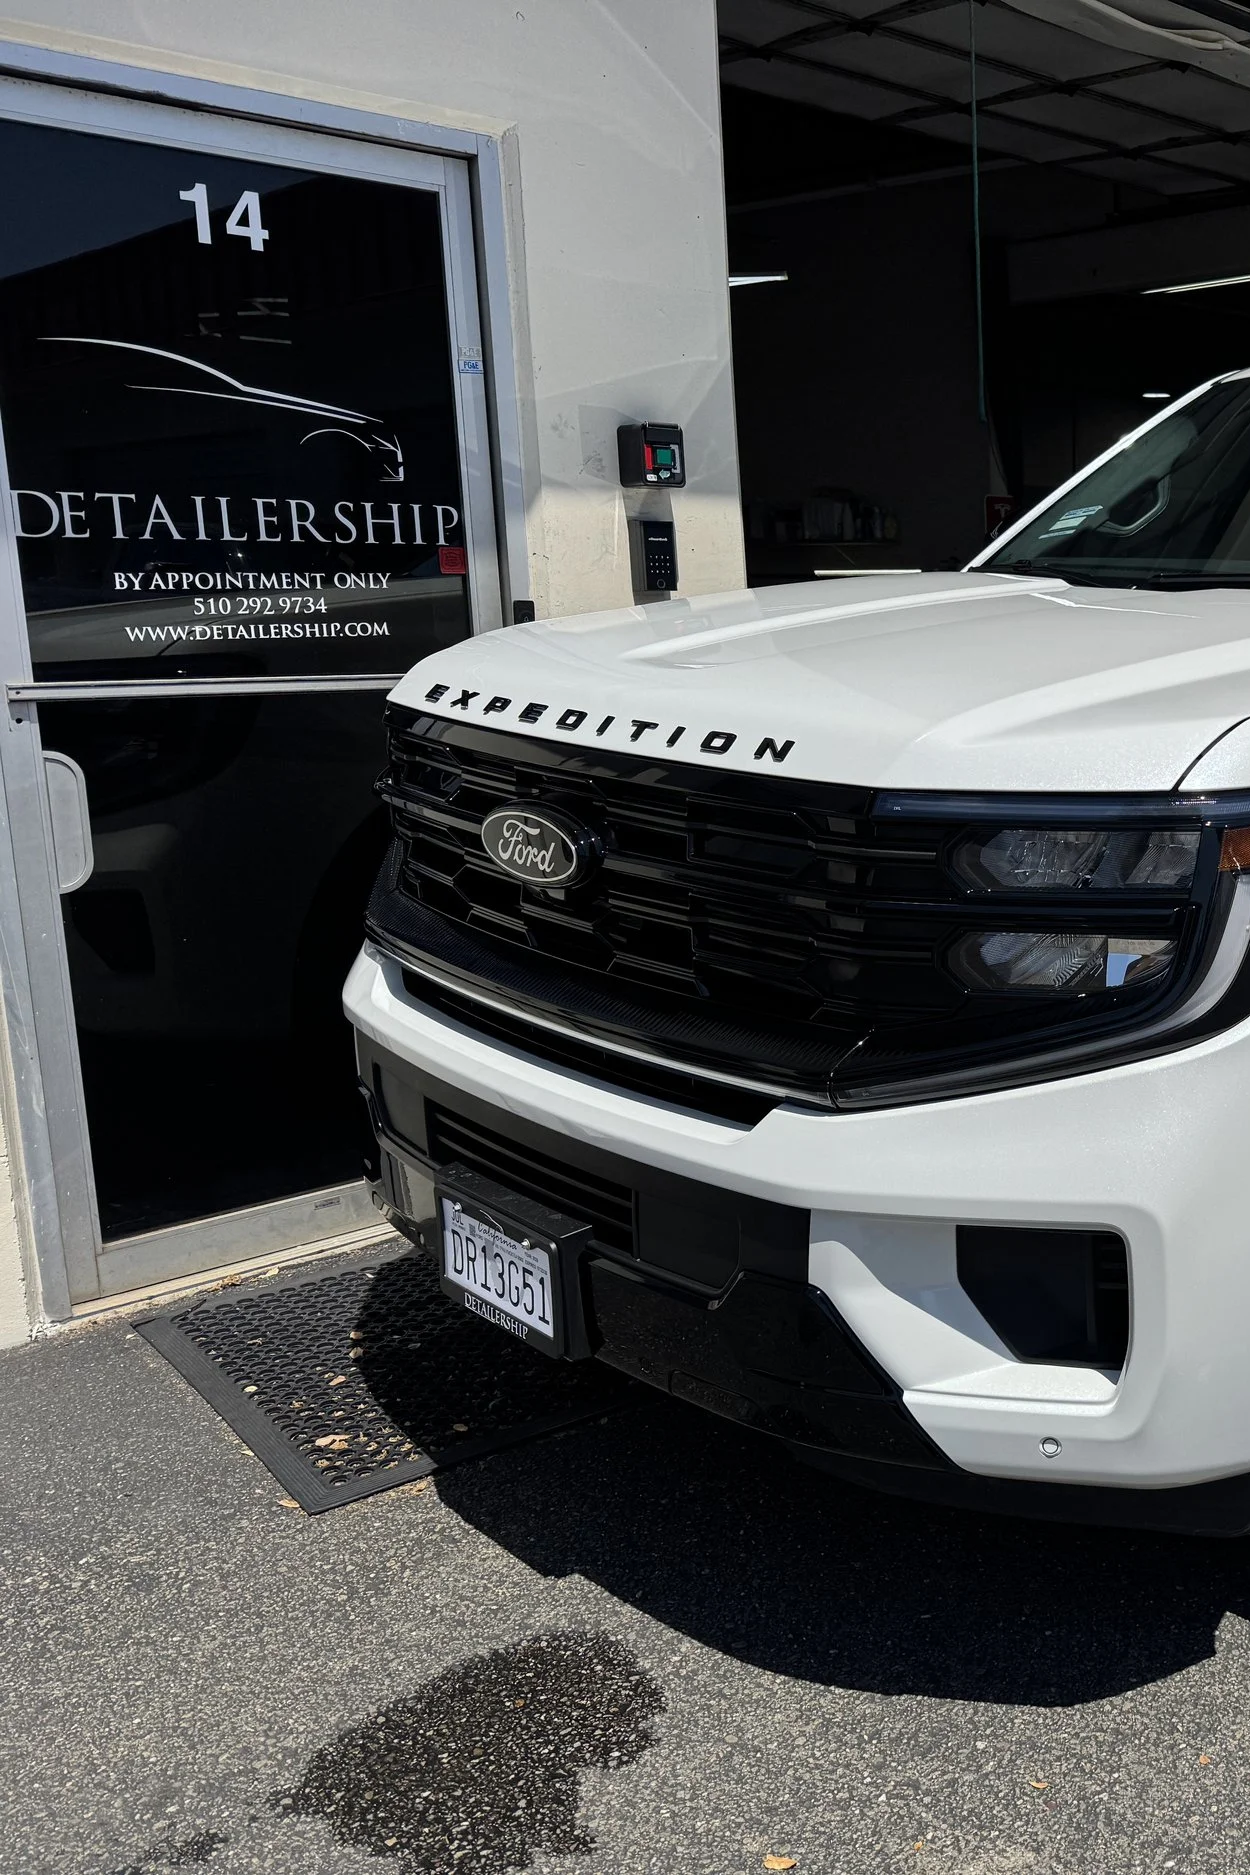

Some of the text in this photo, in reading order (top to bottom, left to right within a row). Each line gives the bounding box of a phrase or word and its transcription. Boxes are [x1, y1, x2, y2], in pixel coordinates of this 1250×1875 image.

[179, 182, 270, 252] 14
[10, 490, 459, 546] DETAILERSHIP
[113, 572, 391, 591] BY APPOINTMENT ONLY
[193, 597, 328, 616] 510 292 9734
[125, 621, 391, 642] WWW.DETAILERSHIP.COM
[424, 683, 796, 763] EXPEDITION
[498, 819, 556, 874] Ford
[478, 1222, 517, 1250] California
[451, 1229, 550, 1326] DR13G51
[464, 1292, 529, 1340] DETAILERSHIP
